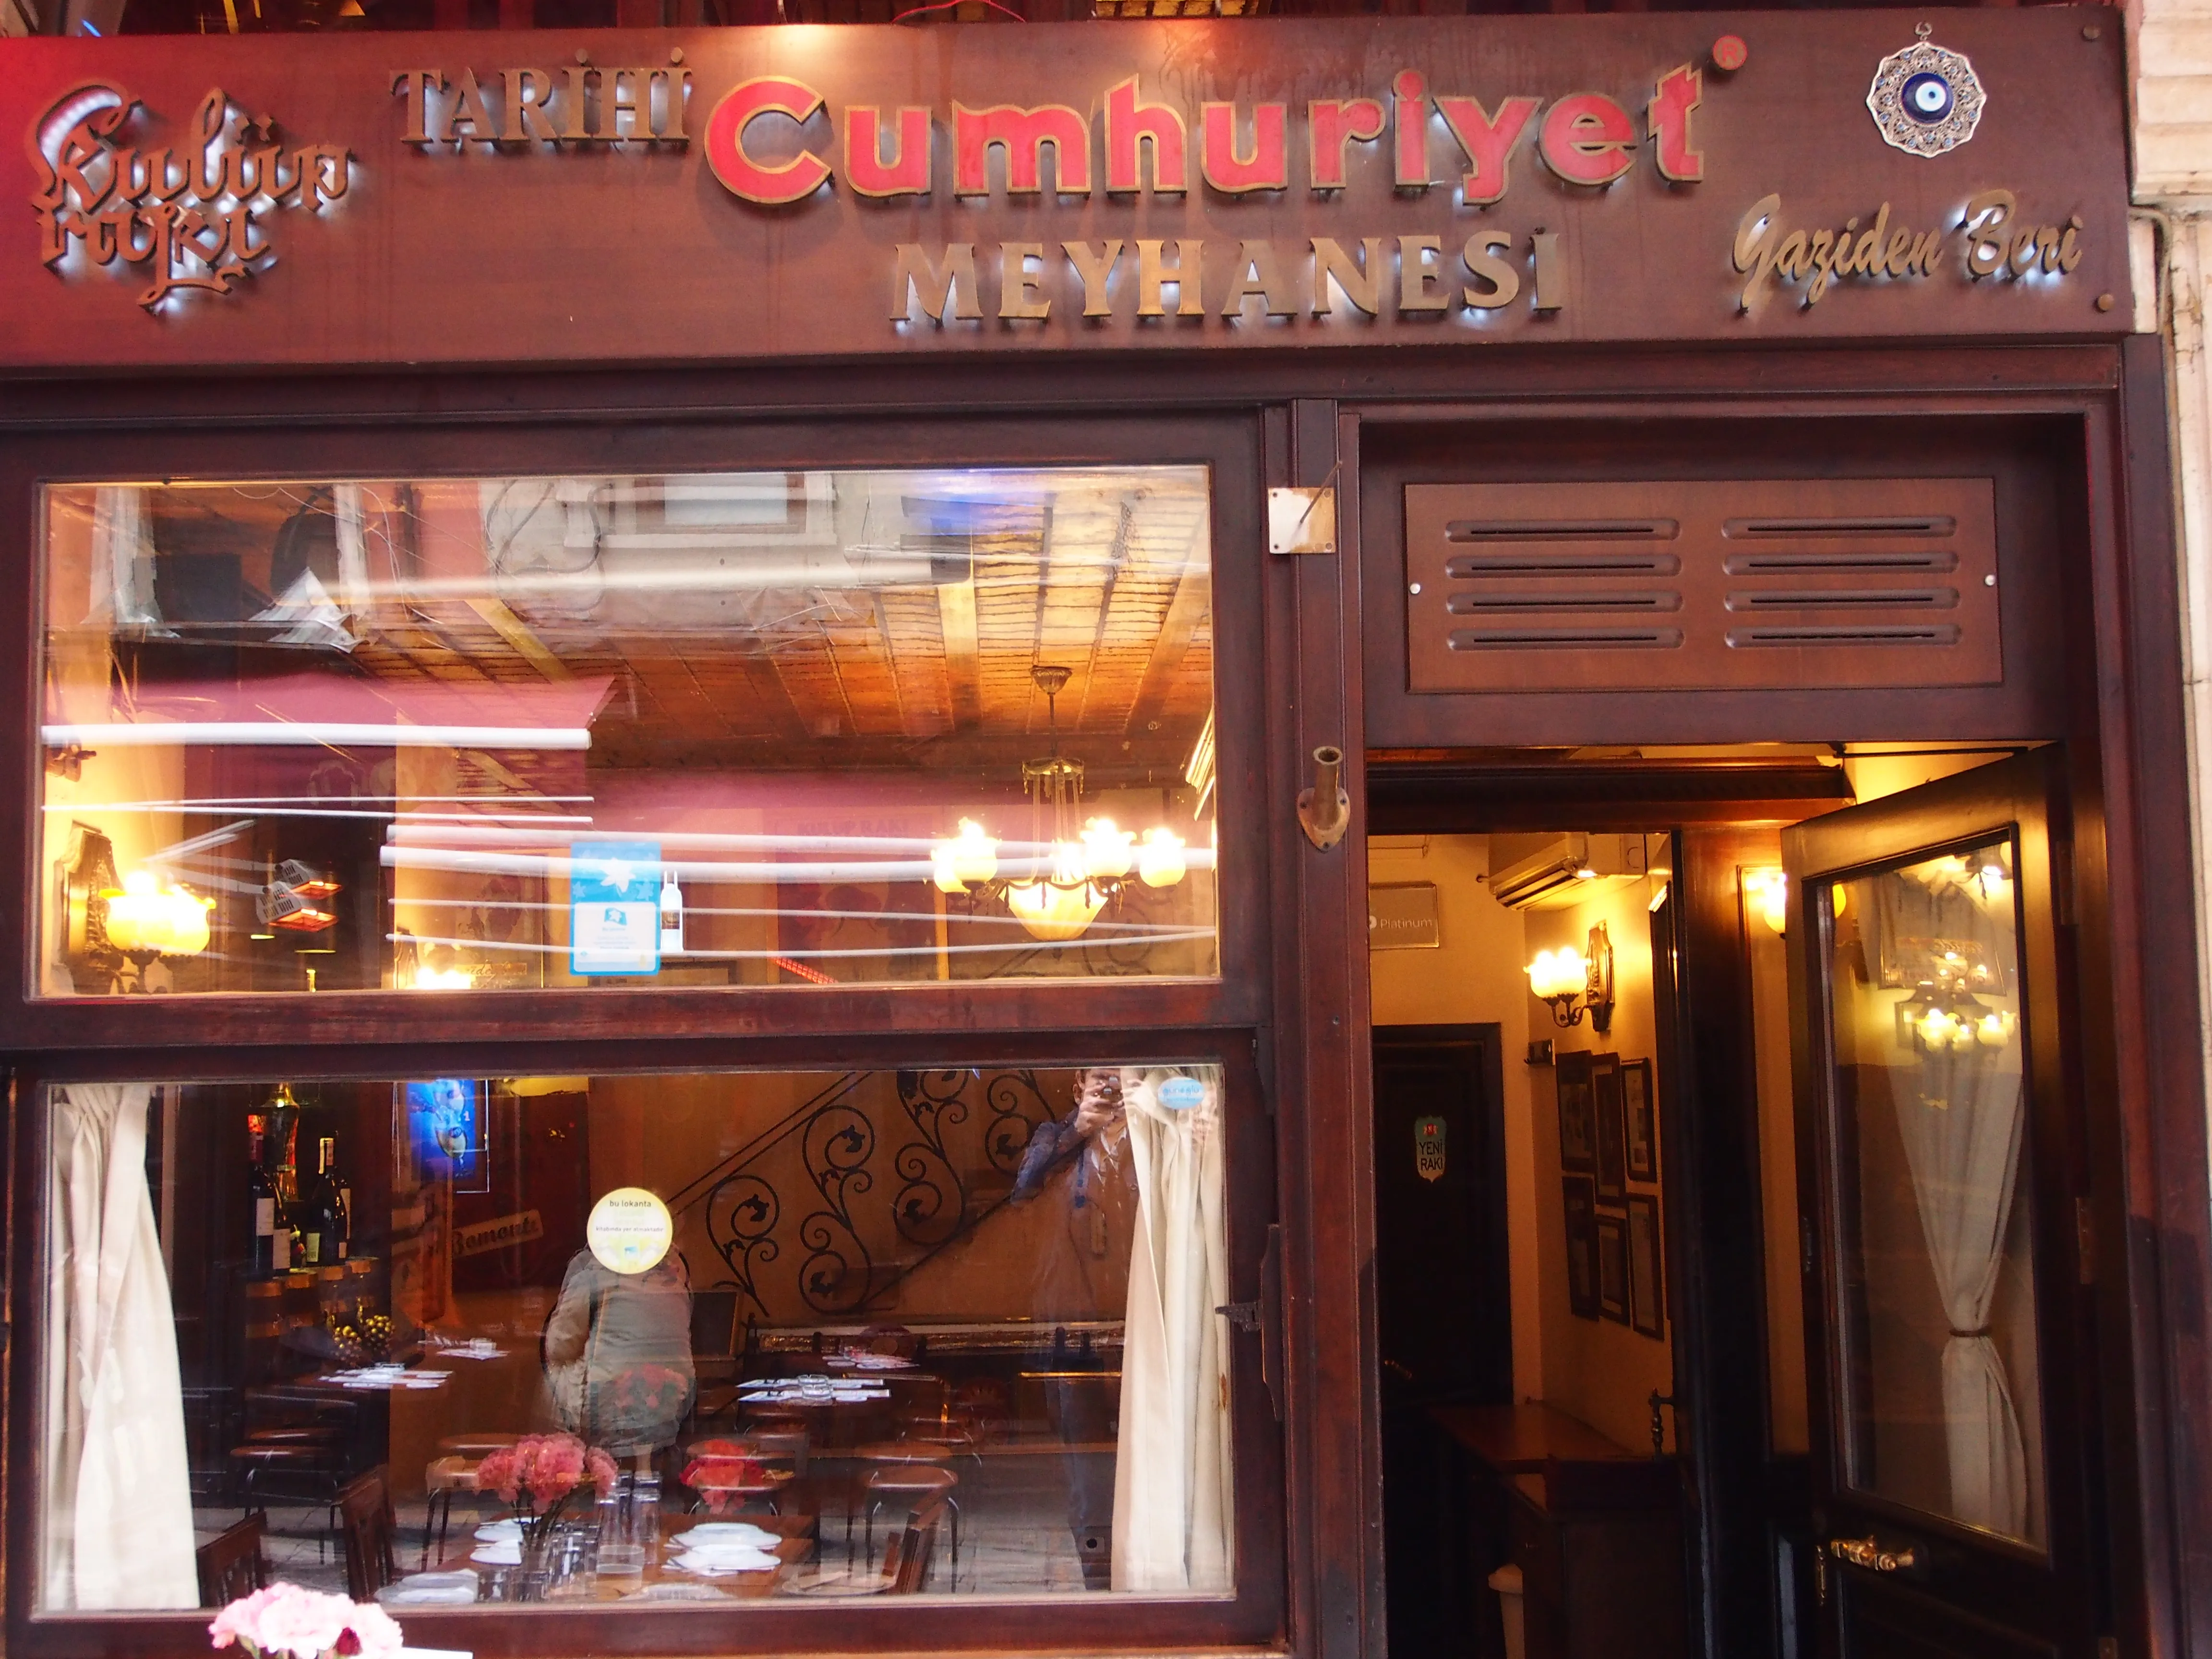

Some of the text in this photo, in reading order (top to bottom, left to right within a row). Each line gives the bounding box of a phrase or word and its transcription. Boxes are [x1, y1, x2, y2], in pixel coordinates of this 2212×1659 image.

[390, 47, 693, 144] TARİHİ
[704, 61, 1704, 206] Cumhuriyet
[1732, 189, 2084, 312] Gaziden Beri
[1380, 918, 1432, 929] Platinum
[1419, 1139, 1443, 1155] YENİ
[1420, 1157, 1443, 1171] RAKI
